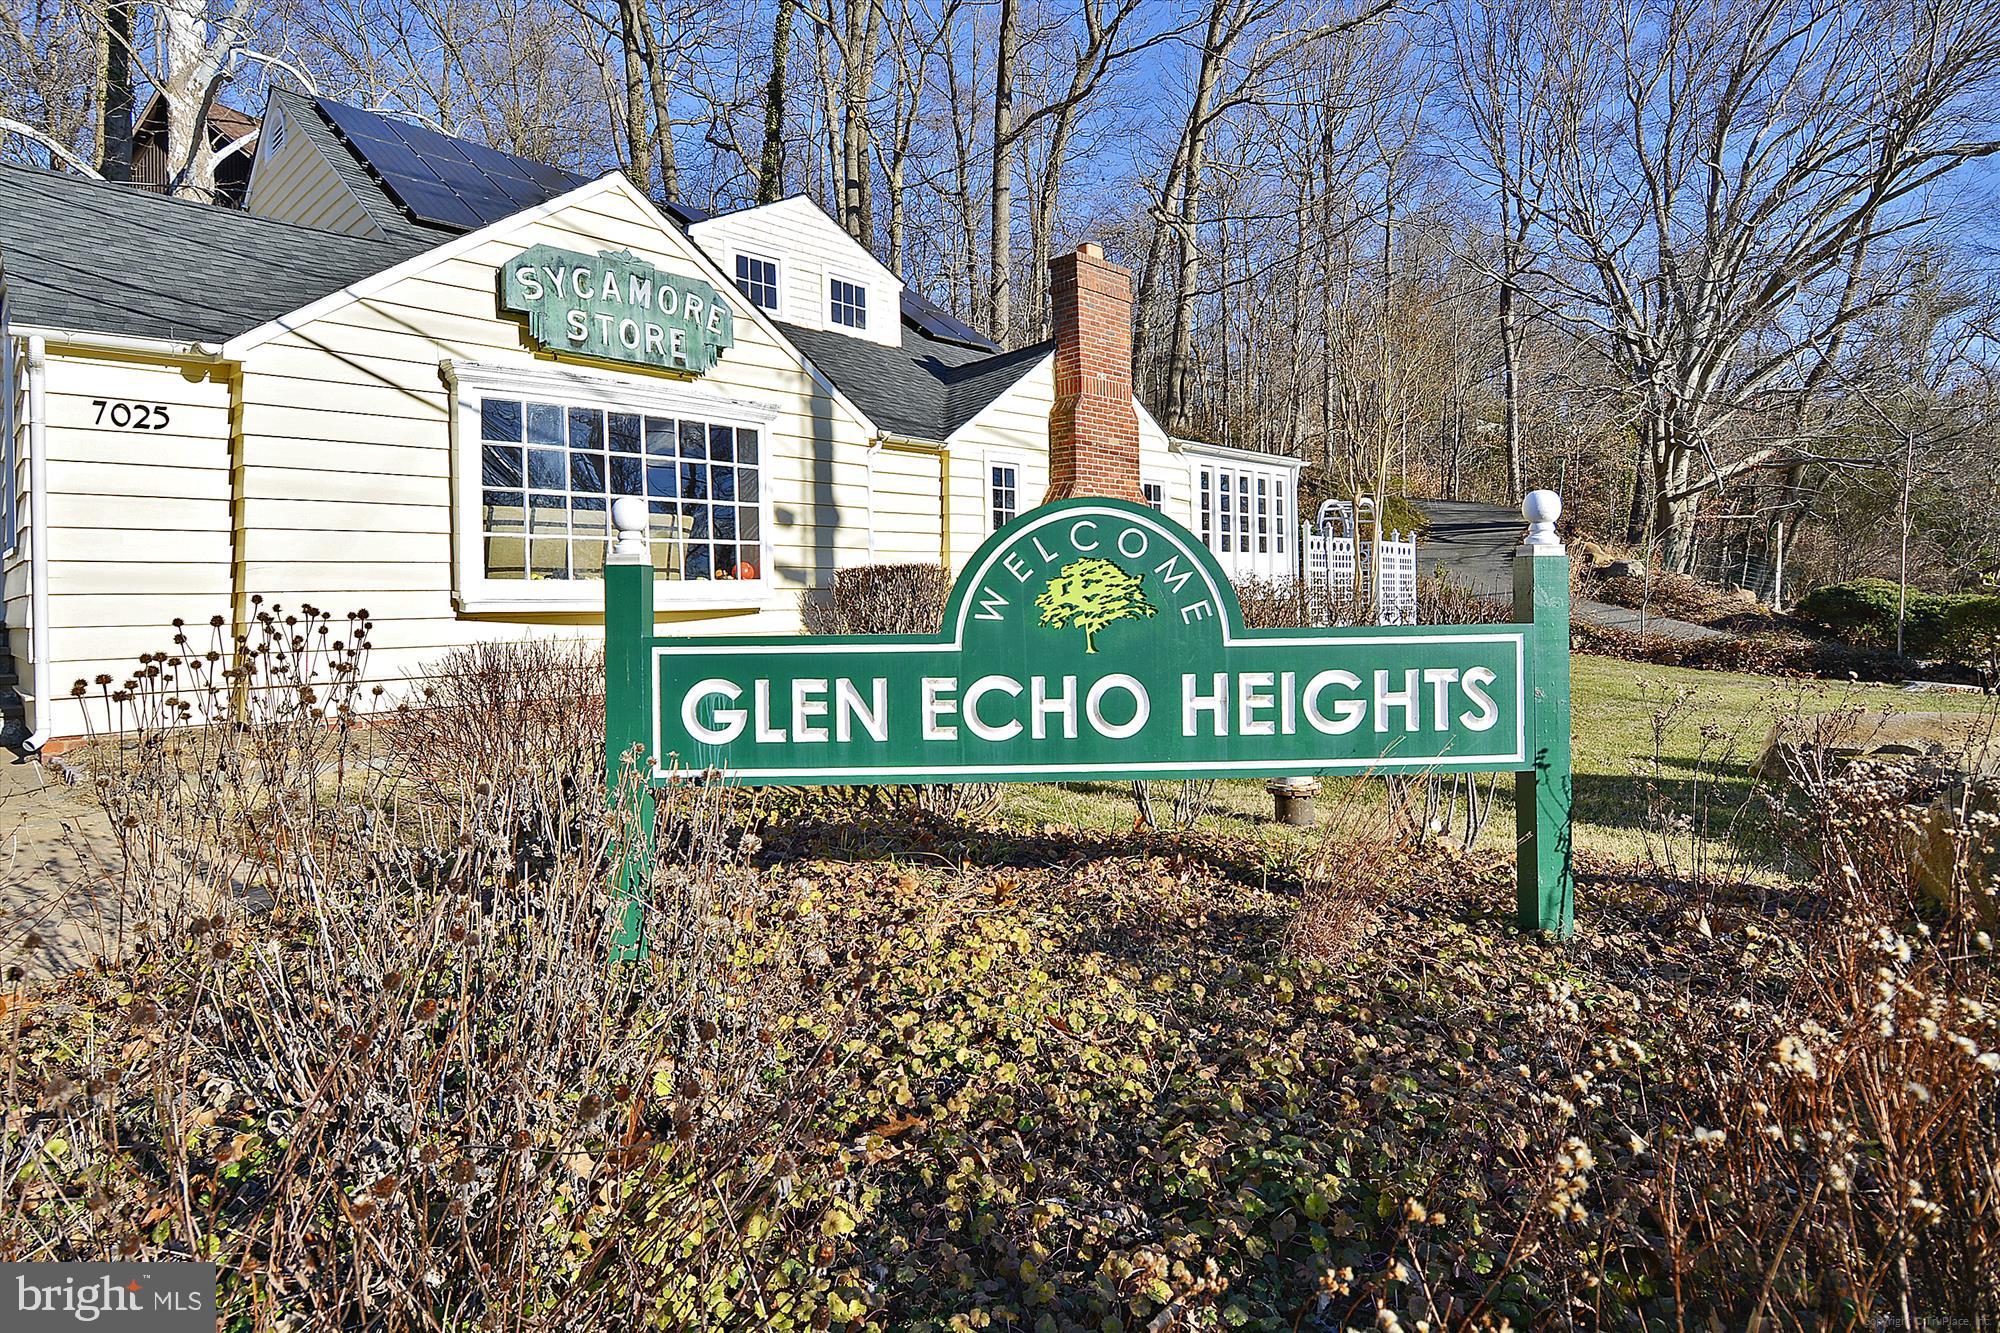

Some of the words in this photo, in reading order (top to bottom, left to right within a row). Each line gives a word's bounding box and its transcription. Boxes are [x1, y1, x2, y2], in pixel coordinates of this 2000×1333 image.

[515, 267, 726, 335] SYCAMORE
[566, 310, 687, 358] STORE
[92, 400, 170, 430] 7025
[974, 520, 1214, 625] WELCOME
[681, 678, 888, 745] GLEN
[921, 674, 1151, 742] ECHO
[1181, 667, 1498, 736] HEIGHTS
